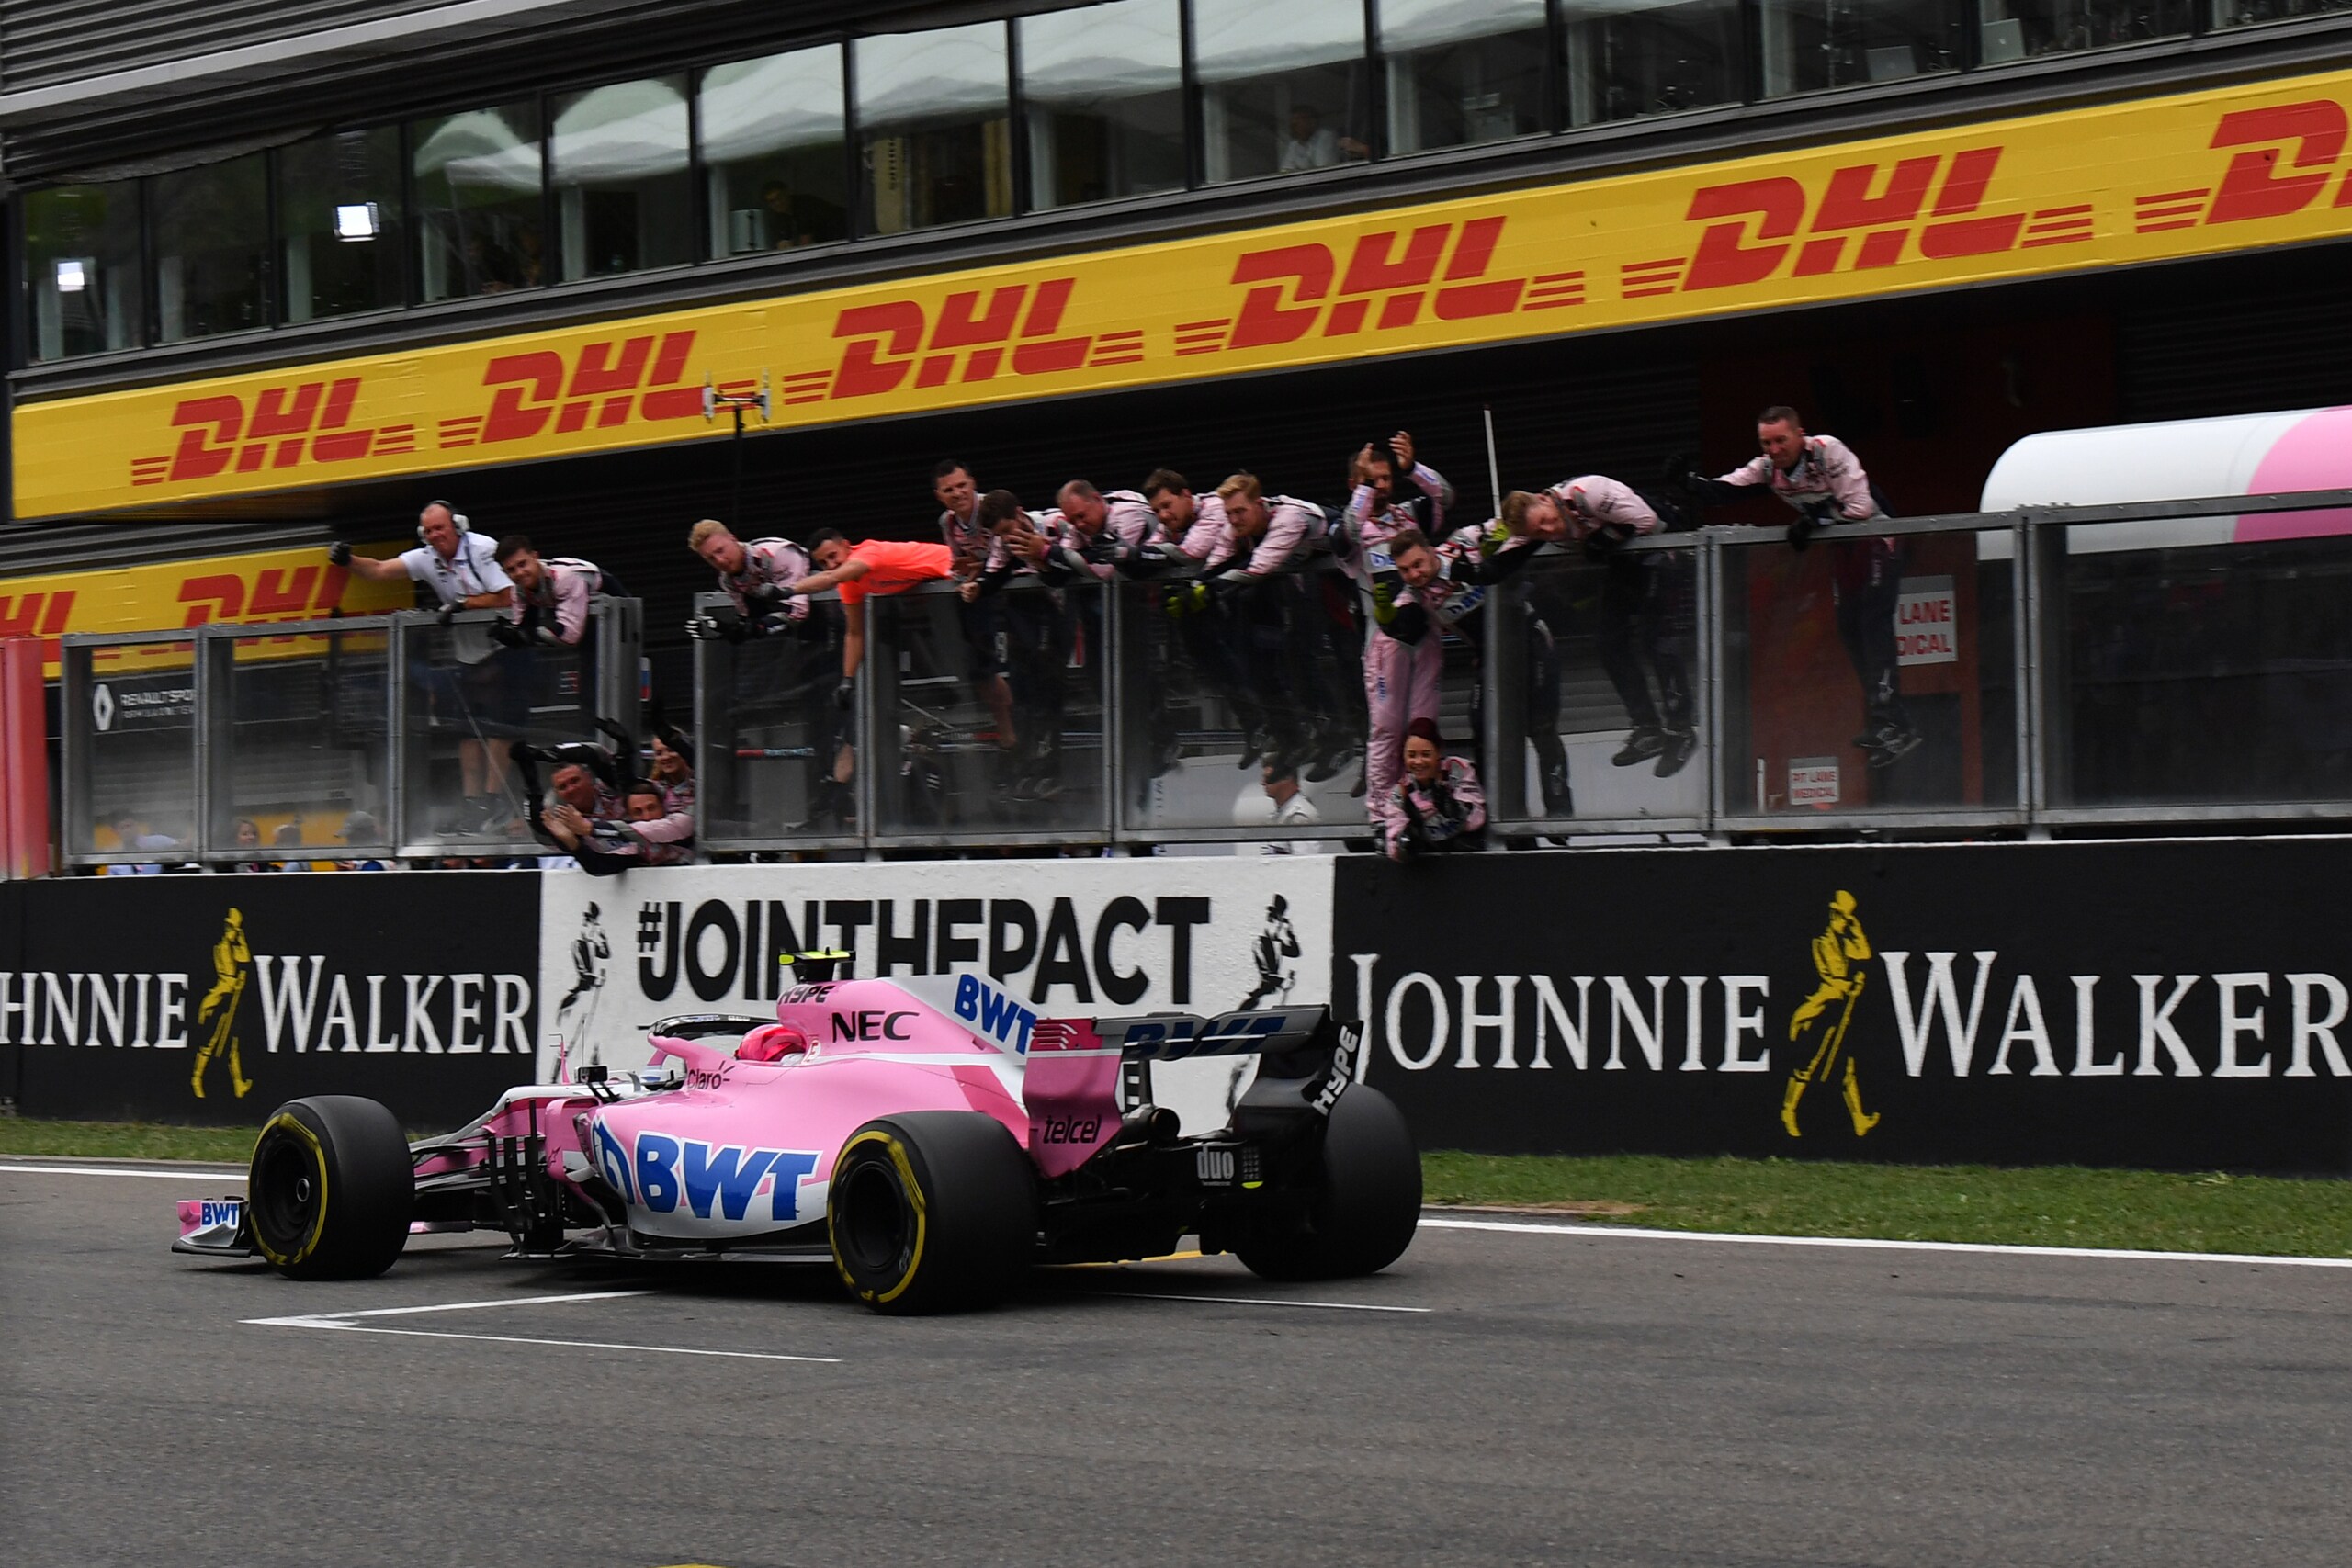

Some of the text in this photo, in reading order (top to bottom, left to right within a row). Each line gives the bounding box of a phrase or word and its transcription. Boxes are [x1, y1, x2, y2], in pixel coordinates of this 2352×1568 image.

[170, 99, 2352, 482] DHL DHL DHL DHL DHL D
[1899, 599, 1951, 624] LANE
[777, 985, 837, 1005] HYPE
[831, 1011, 919, 1043] NEC
[954, 974, 1038, 1055] BWT
[1123, 1016, 1287, 1058] BWT
[1311, 1025, 1359, 1116] HYPE
[1043, 1114, 1102, 1144] telcel
[635, 1133, 820, 1222] BWT
[1197, 1146, 1234, 1179] duo
[201, 1202, 239, 1225] BWT
